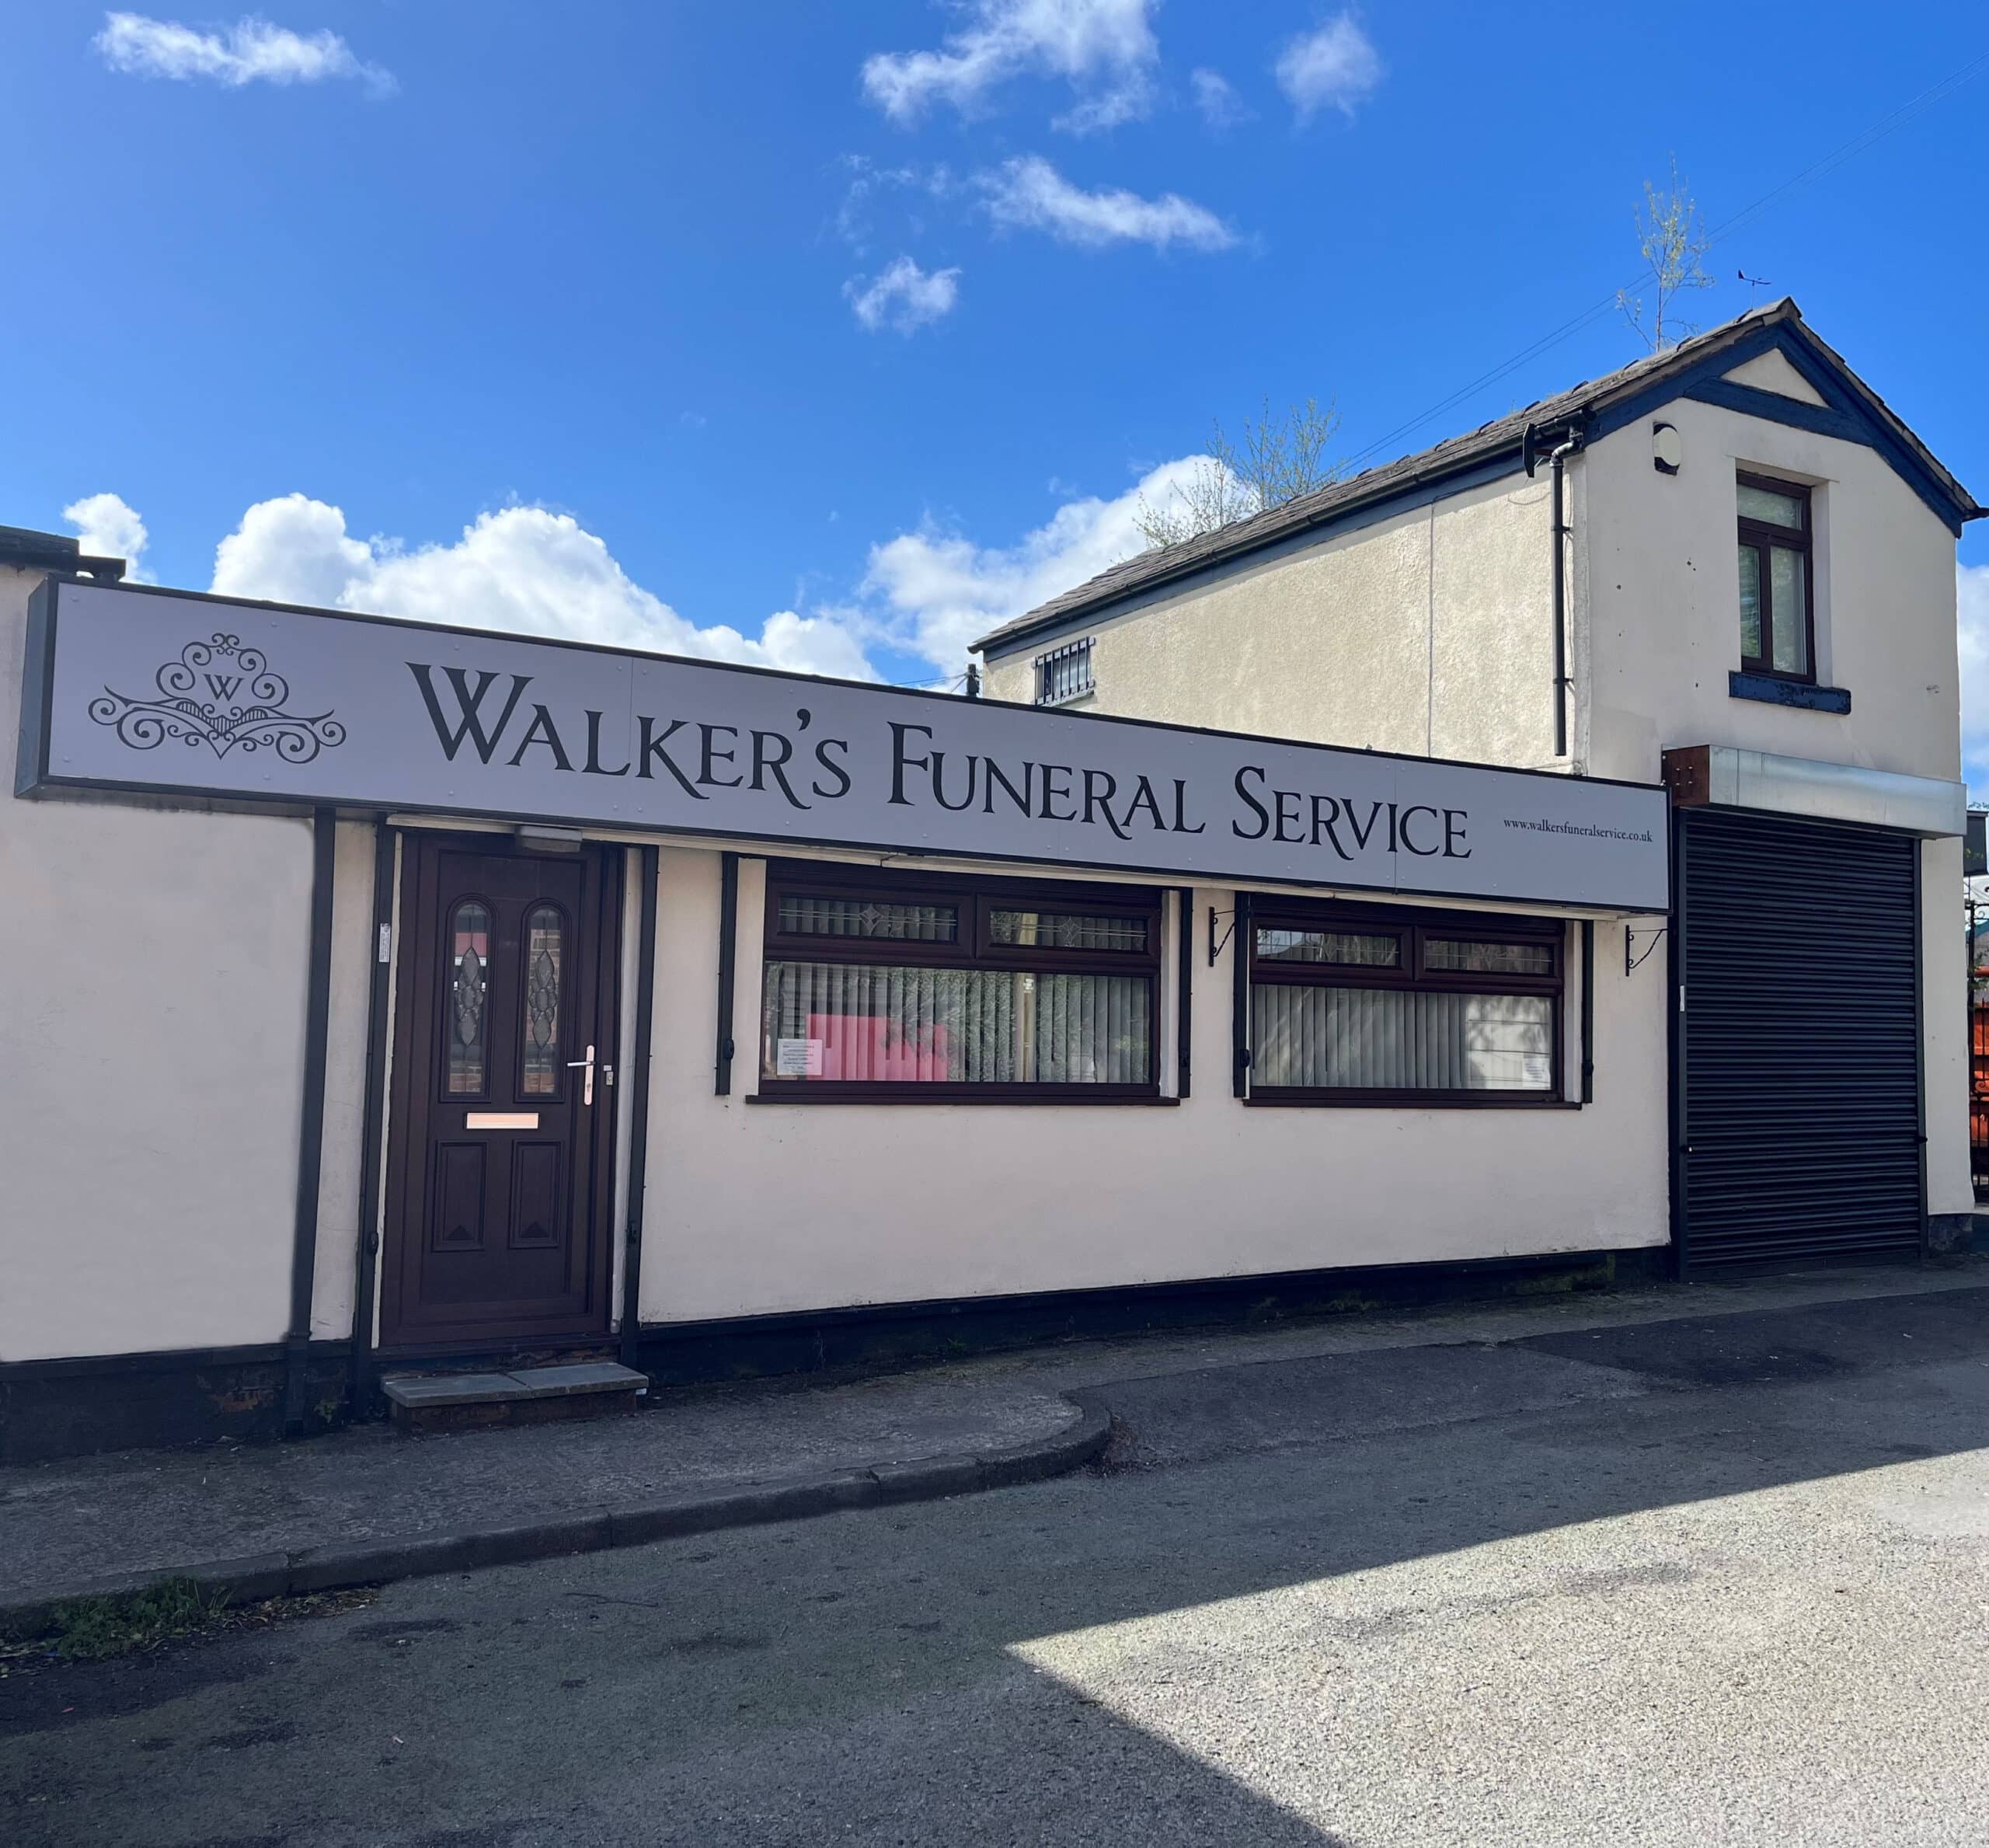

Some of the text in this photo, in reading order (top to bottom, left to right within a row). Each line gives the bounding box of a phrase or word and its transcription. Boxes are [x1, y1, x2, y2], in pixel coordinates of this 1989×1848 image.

[204, 674, 242, 701] W
[404, 661, 1472, 861] WALKER'S FUNERAL SERVICE
[1503, 818, 1653, 842] www.walkersfuneralservice.co.uk
